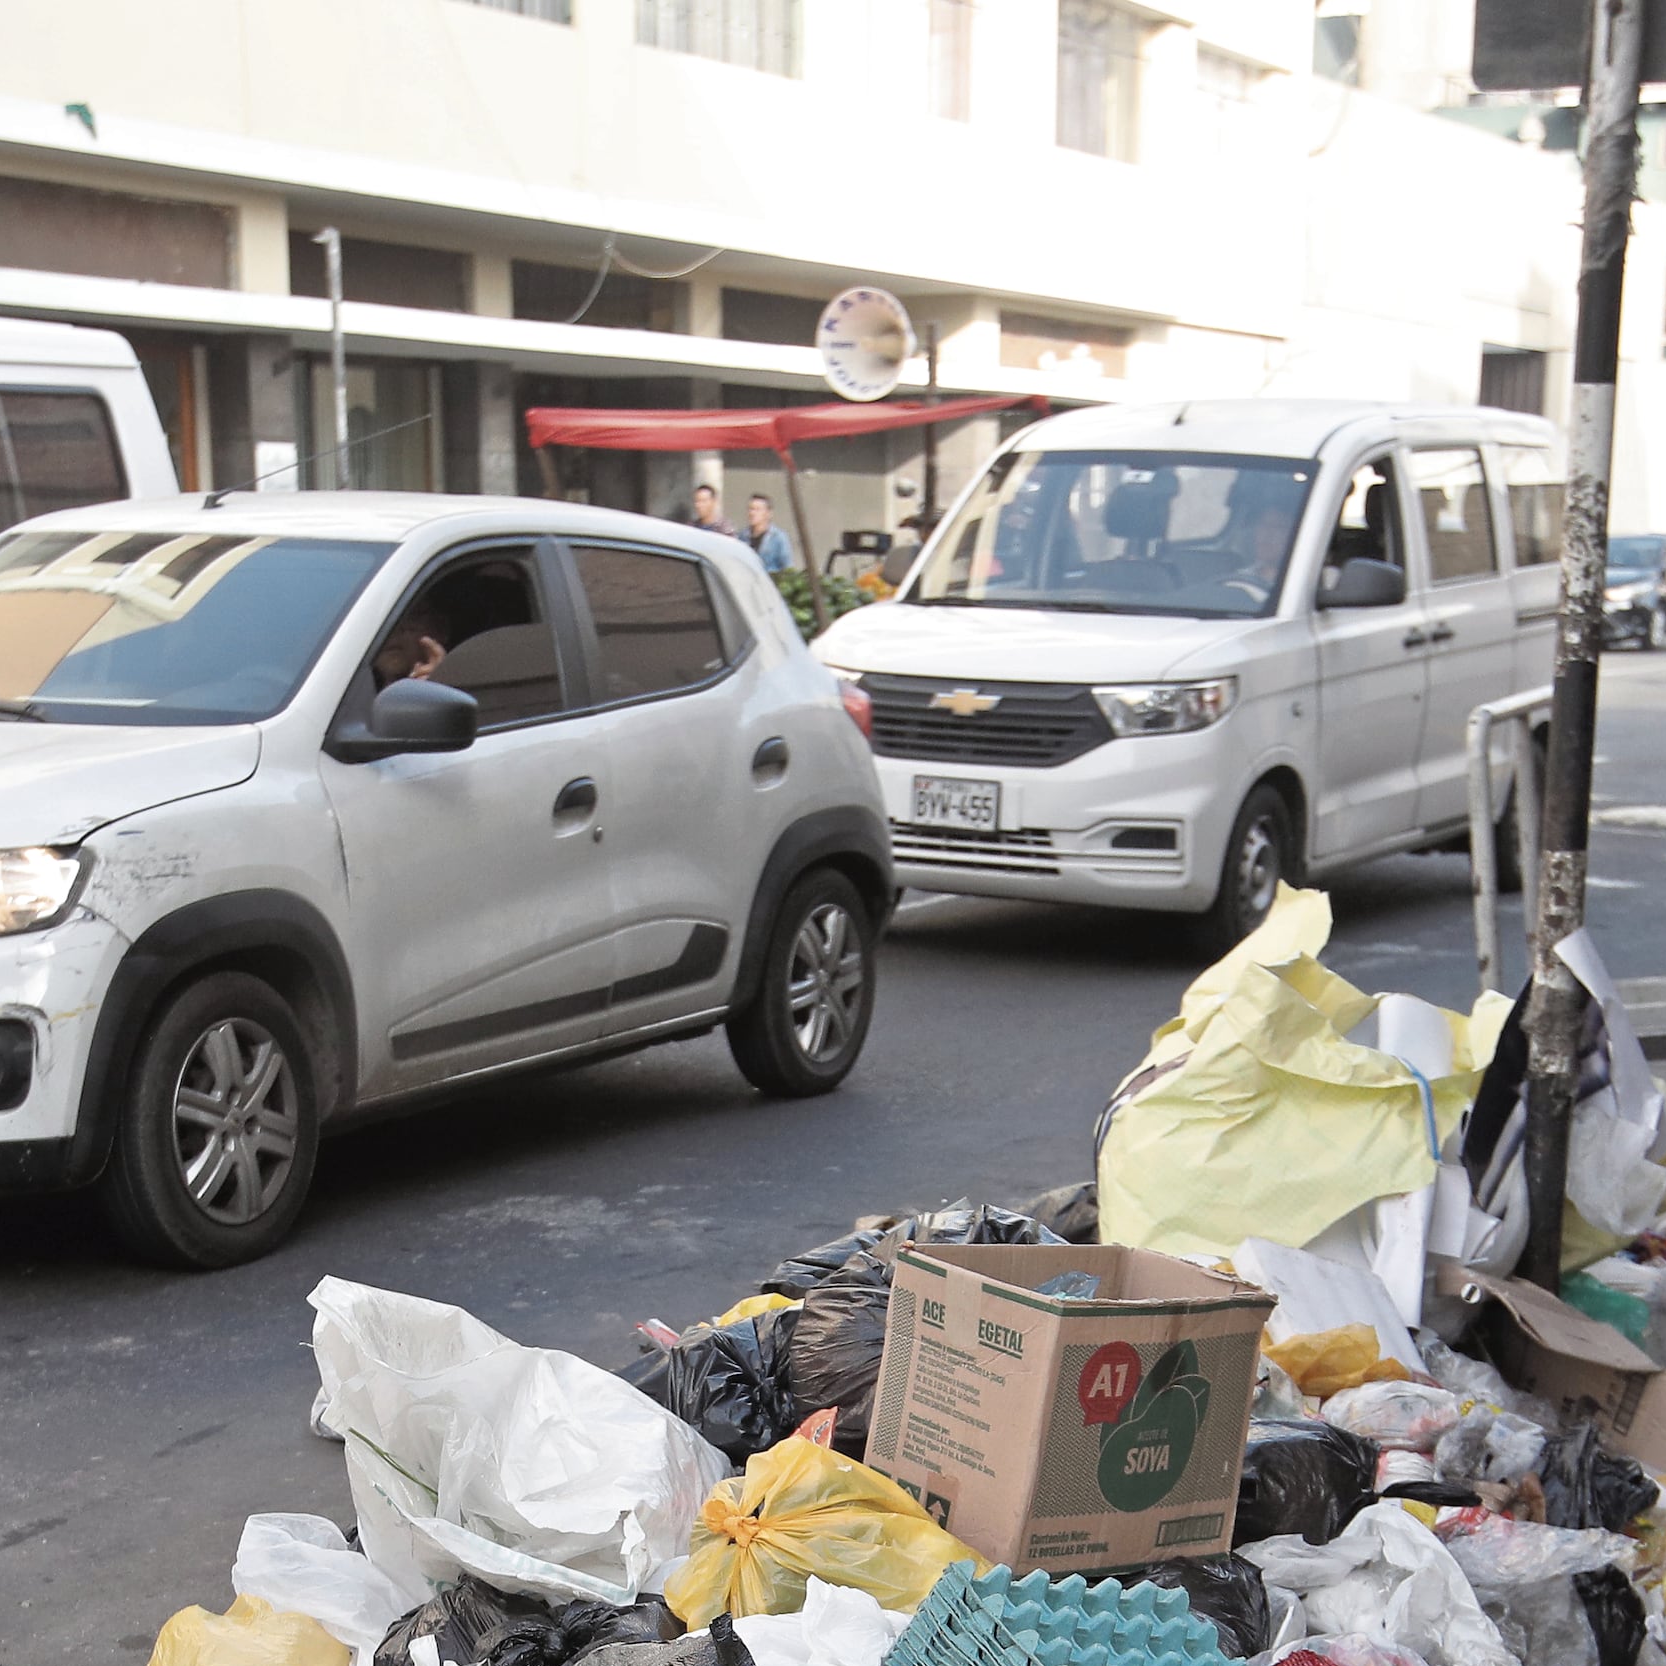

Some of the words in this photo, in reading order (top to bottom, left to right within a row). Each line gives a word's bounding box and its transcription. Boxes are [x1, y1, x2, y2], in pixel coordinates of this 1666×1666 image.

[922, 1298, 946, 1324] ACE
[978, 1318, 1024, 1353] EGETAL
[1088, 1363, 1129, 1398] A1
[1123, 1444, 1170, 1475] SOYA
